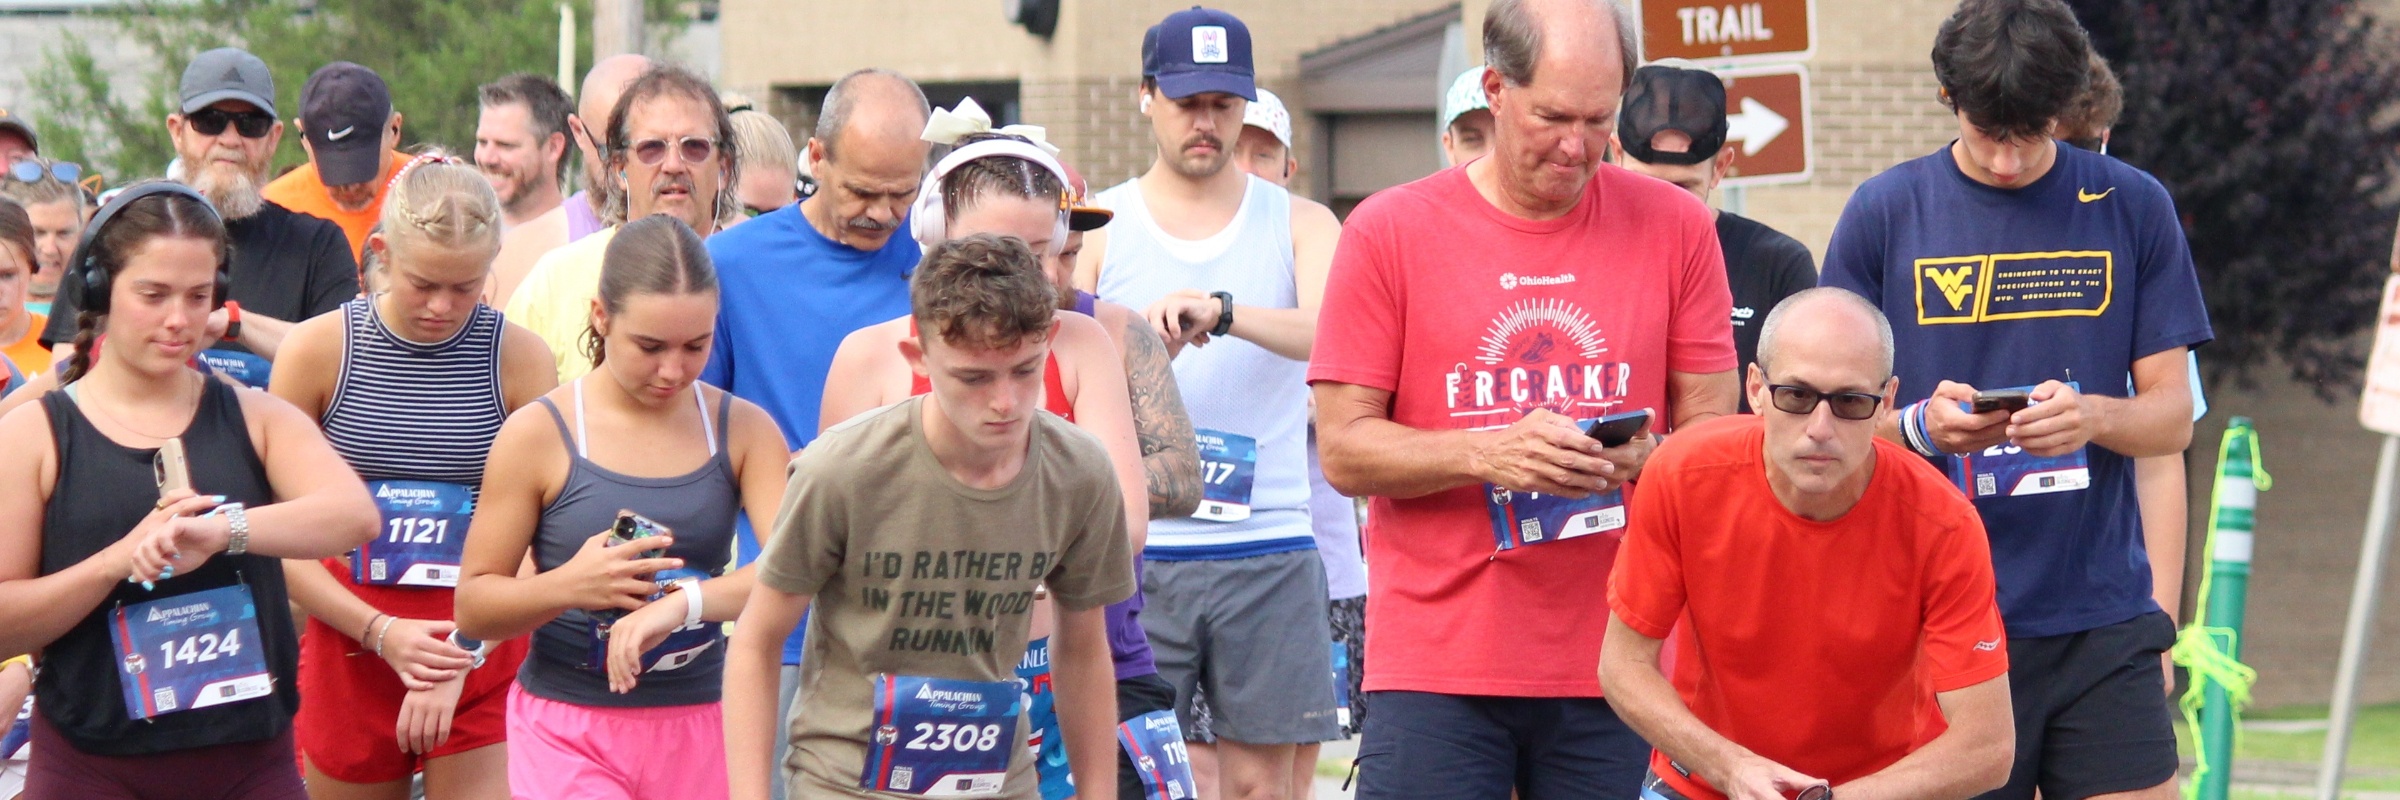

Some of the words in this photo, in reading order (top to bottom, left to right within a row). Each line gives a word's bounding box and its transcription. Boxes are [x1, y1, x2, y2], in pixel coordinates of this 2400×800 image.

[1676, 3, 1774, 46] TRAIL
[1519, 273, 1576, 286] OhioHealth
[1998, 270, 2046, 278] ENGINEERED
[1997, 280, 2064, 290] SPECIFICATIONS
[1200, 460, 1236, 485] 17
[376, 483, 435, 499] APPALACHIAN
[414, 498, 440, 508] Group
[389, 517, 448, 544] 1121
[863, 551, 902, 579] I'D
[912, 551, 1022, 581] RATHER
[147, 602, 209, 622] APPALACHIAN
[862, 587, 889, 612] IN
[900, 591, 955, 619] THE
[190, 612, 217, 623] Group
[160, 628, 241, 669] 1424
[915, 683, 982, 702] APPALACHIAN
[928, 699, 955, 712] Timing
[958, 701, 985, 711] Group
[905, 722, 1000, 752] 2308
